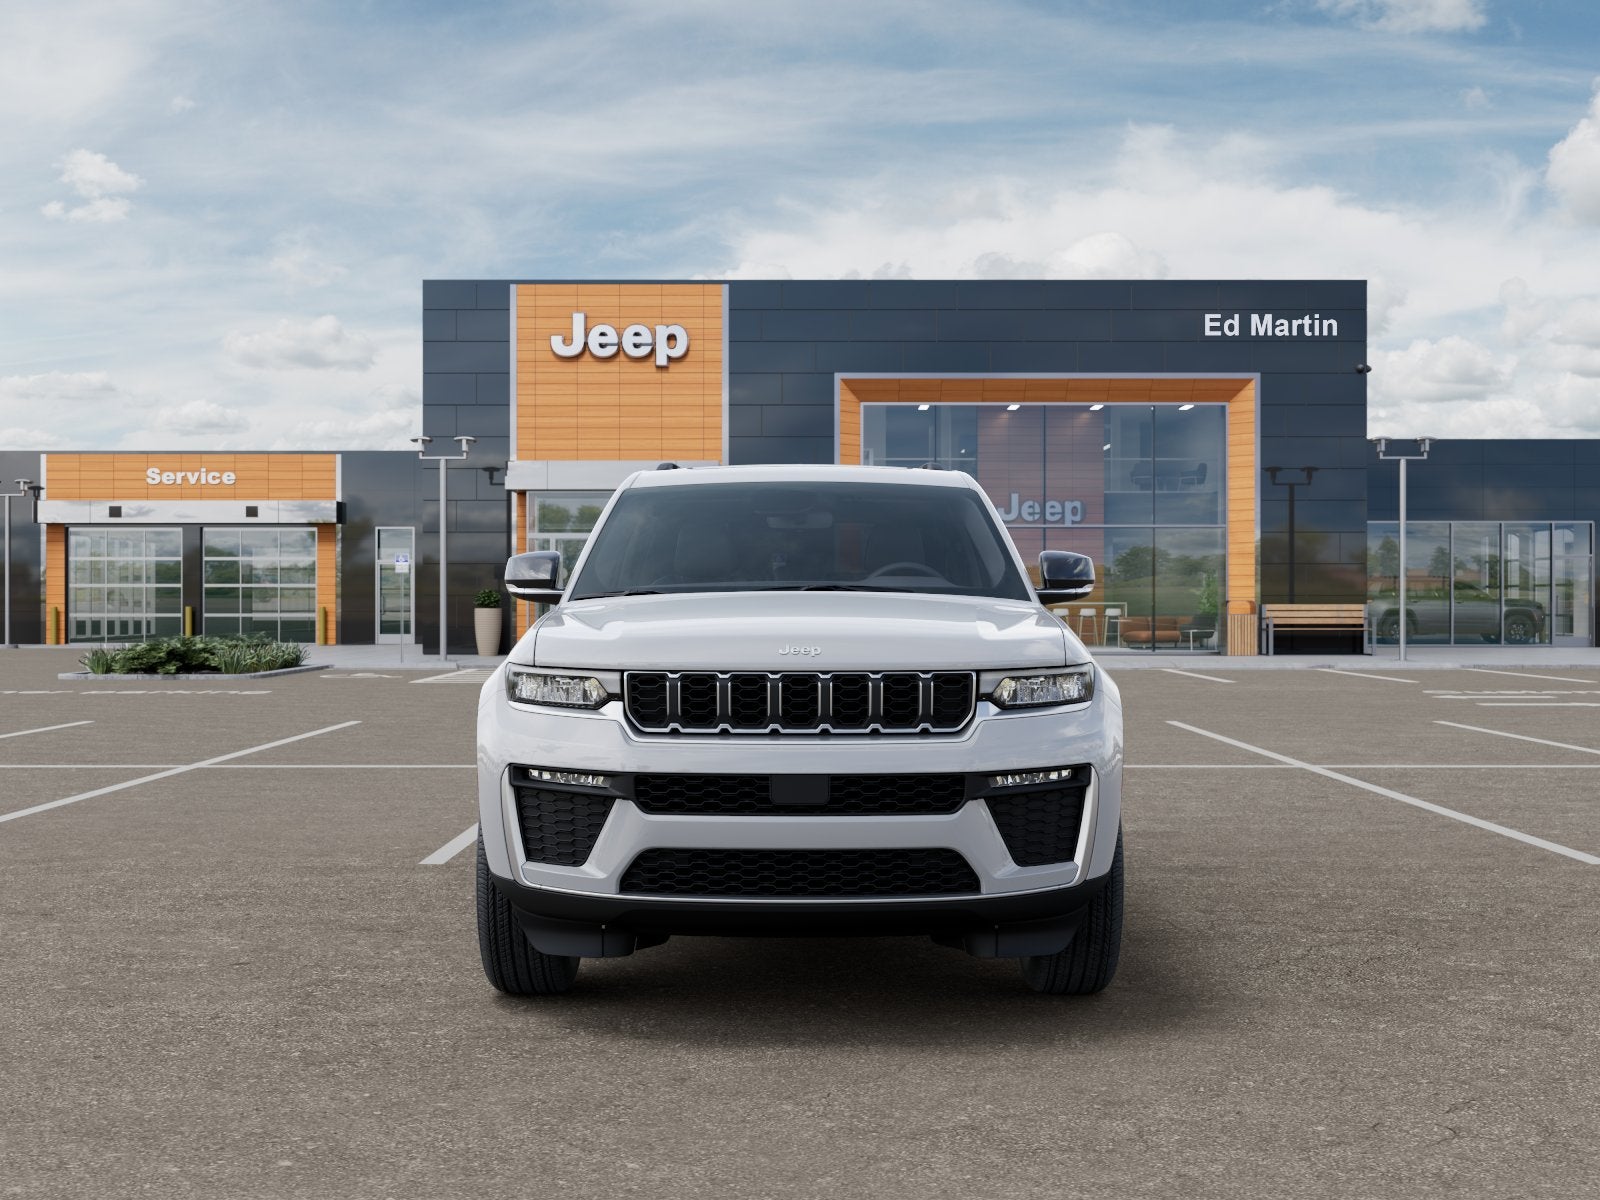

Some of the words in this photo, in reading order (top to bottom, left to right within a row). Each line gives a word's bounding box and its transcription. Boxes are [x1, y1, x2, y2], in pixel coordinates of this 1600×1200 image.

[1204, 313, 1240, 336] Ed
[1250, 313, 1338, 336] Martin
[550, 312, 690, 368] Jeep
[146, 467, 236, 485] Service
[998, 493, 1083, 526] Jeep
[778, 643, 821, 657] Jeep
